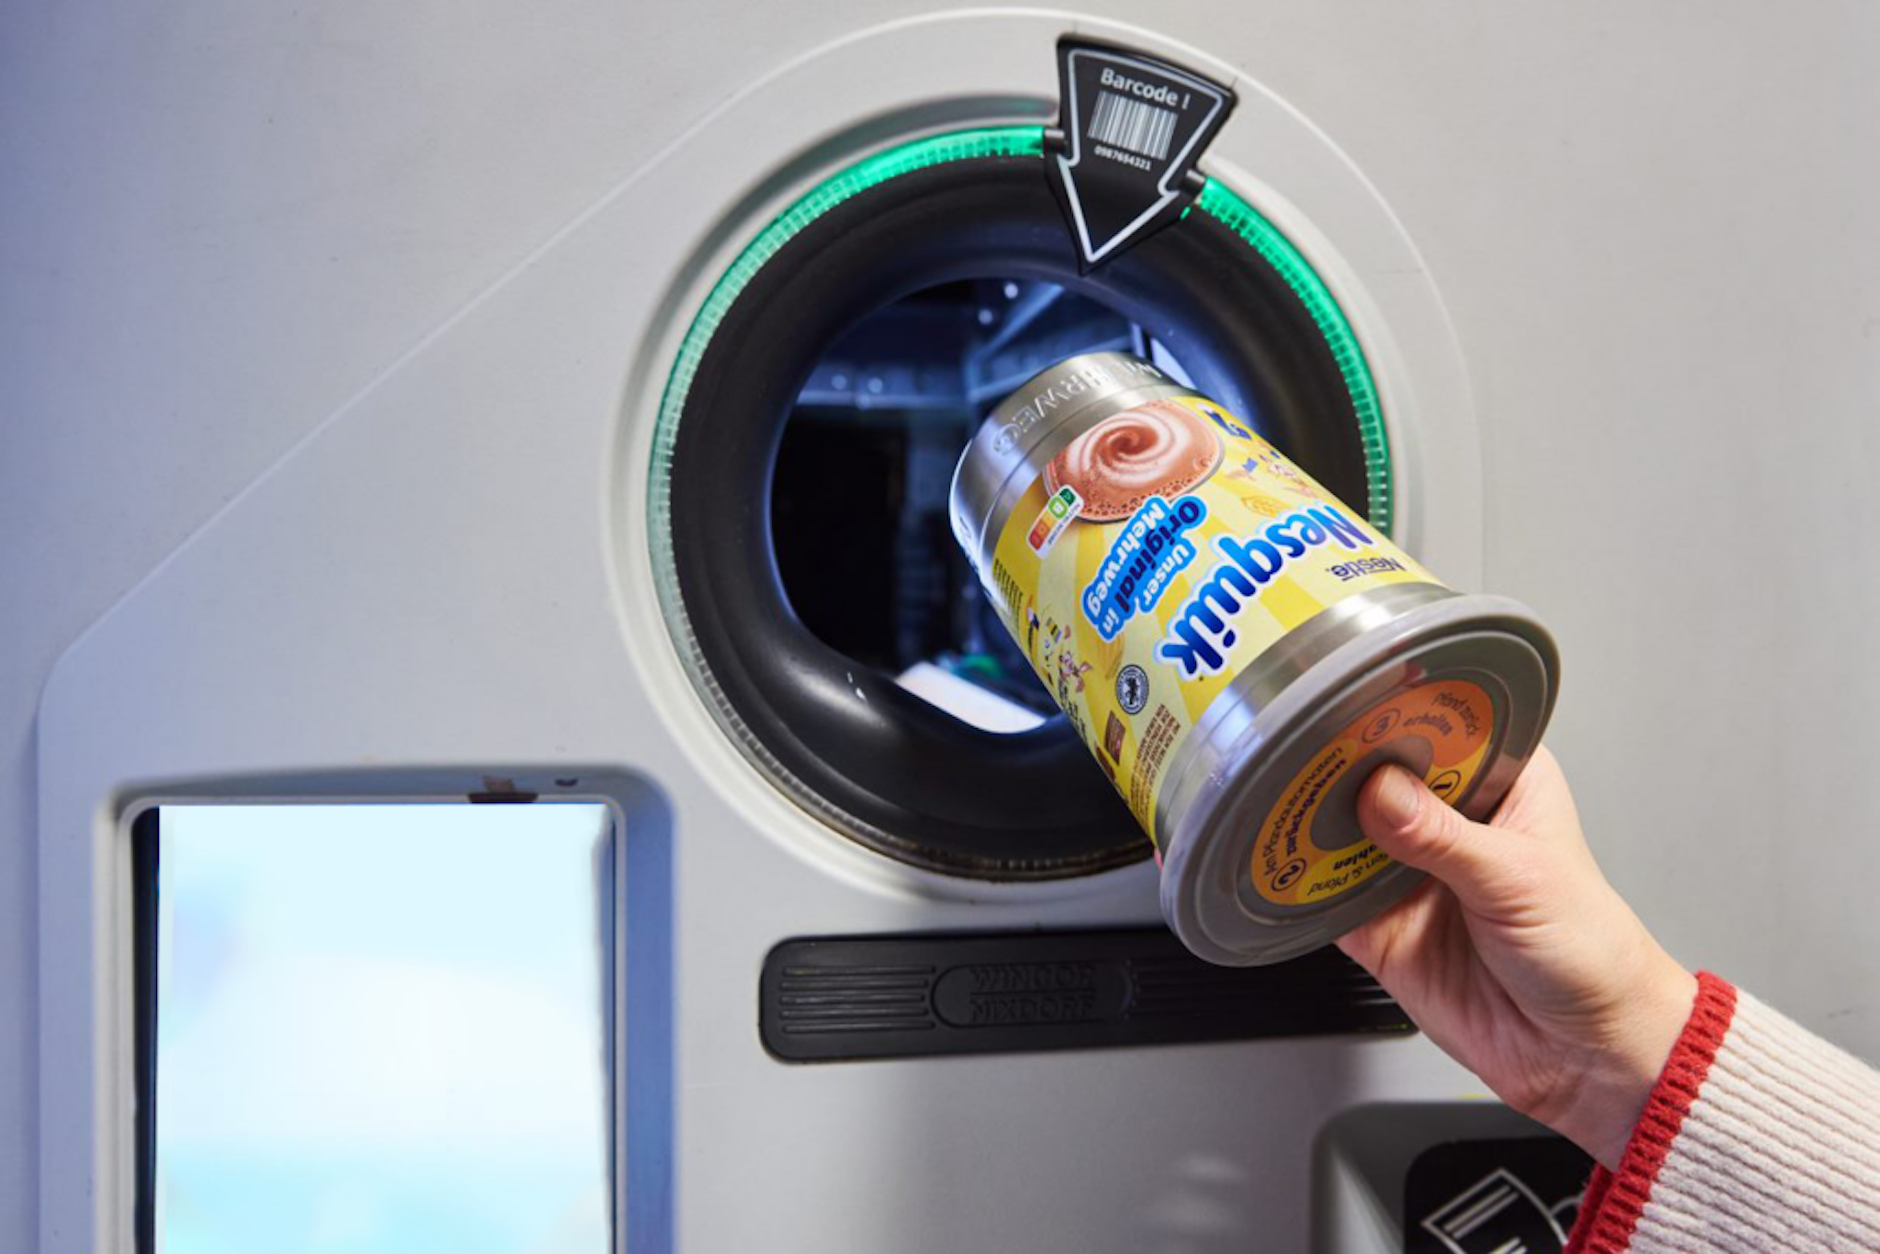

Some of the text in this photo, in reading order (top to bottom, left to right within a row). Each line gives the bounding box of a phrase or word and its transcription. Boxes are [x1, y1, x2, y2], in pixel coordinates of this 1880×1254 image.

[1101, 67, 1178, 106] Barcode
[1094, 145, 1151, 171] 0987654321
[1087, 502, 1166, 617] Mehrweg
[1114, 499, 1200, 613] Original
[1330, 557, 1407, 582] Nestlé
[1143, 544, 1190, 606] Unser
[1162, 504, 1374, 675] Nesquik
[1102, 610, 1120, 634] in
[1278, 864, 1300, 885] 2
[969, 996, 1096, 1023] NIXDORF
